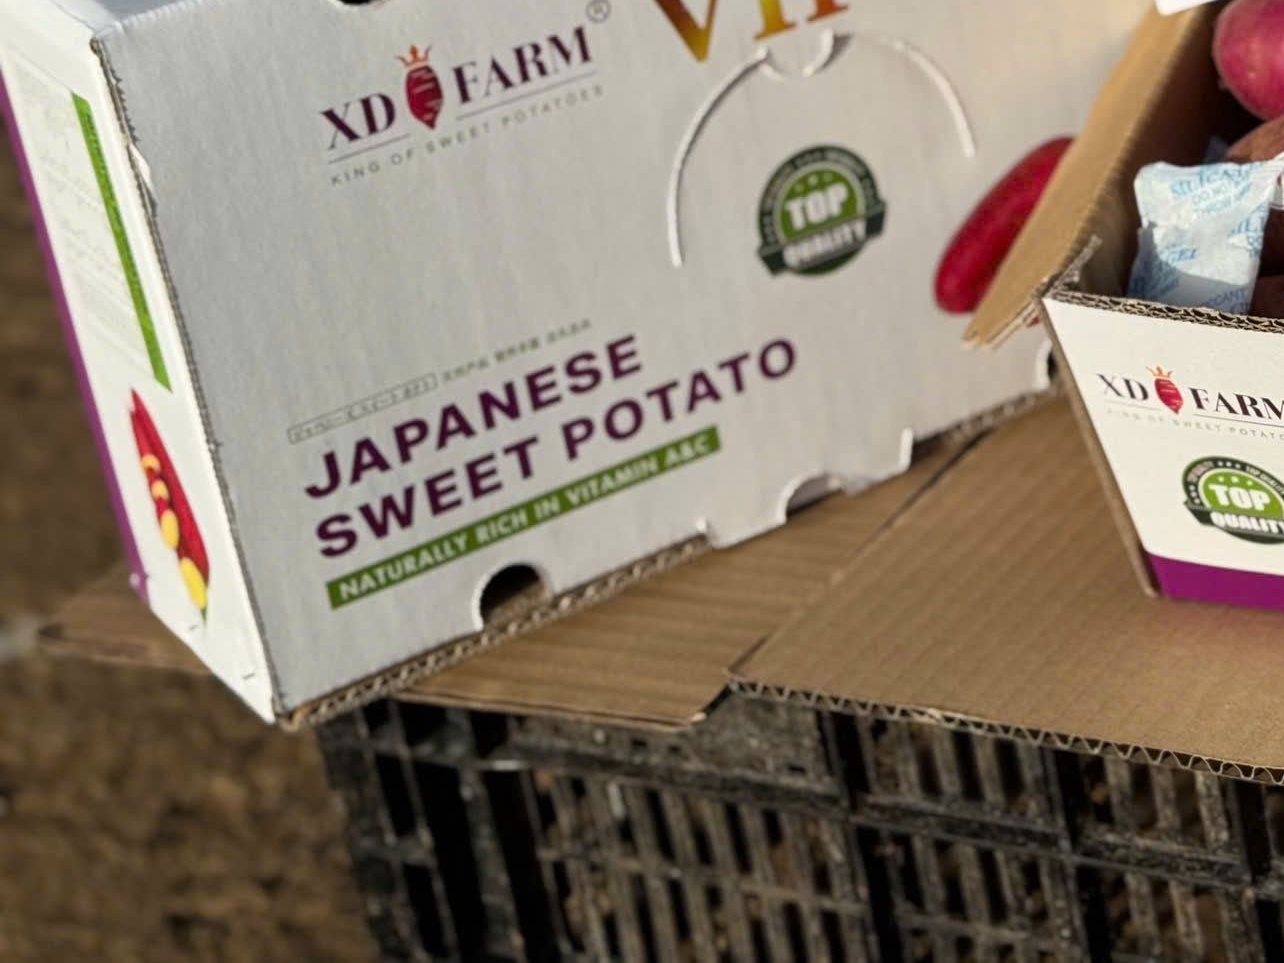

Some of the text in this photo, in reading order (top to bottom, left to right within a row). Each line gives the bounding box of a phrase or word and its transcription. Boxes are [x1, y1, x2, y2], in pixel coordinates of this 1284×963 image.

[321, 92, 396, 151] XD
[425, 122, 492, 155] SWEET
[501, 85, 604, 127] POTATOES
[783, 181, 849, 232] TOP
[1096, 372, 1150, 402] XD
[304, 333, 643, 502] JAPANESE
[1172, 417, 1223, 434] SWEET
[315, 435, 540, 559] SWEET
[561, 338, 796, 461] POTATO
[339, 435, 713, 603] NATURALLY RICH IN VITAMIN A&C
[1207, 483, 1271, 512] TOP
